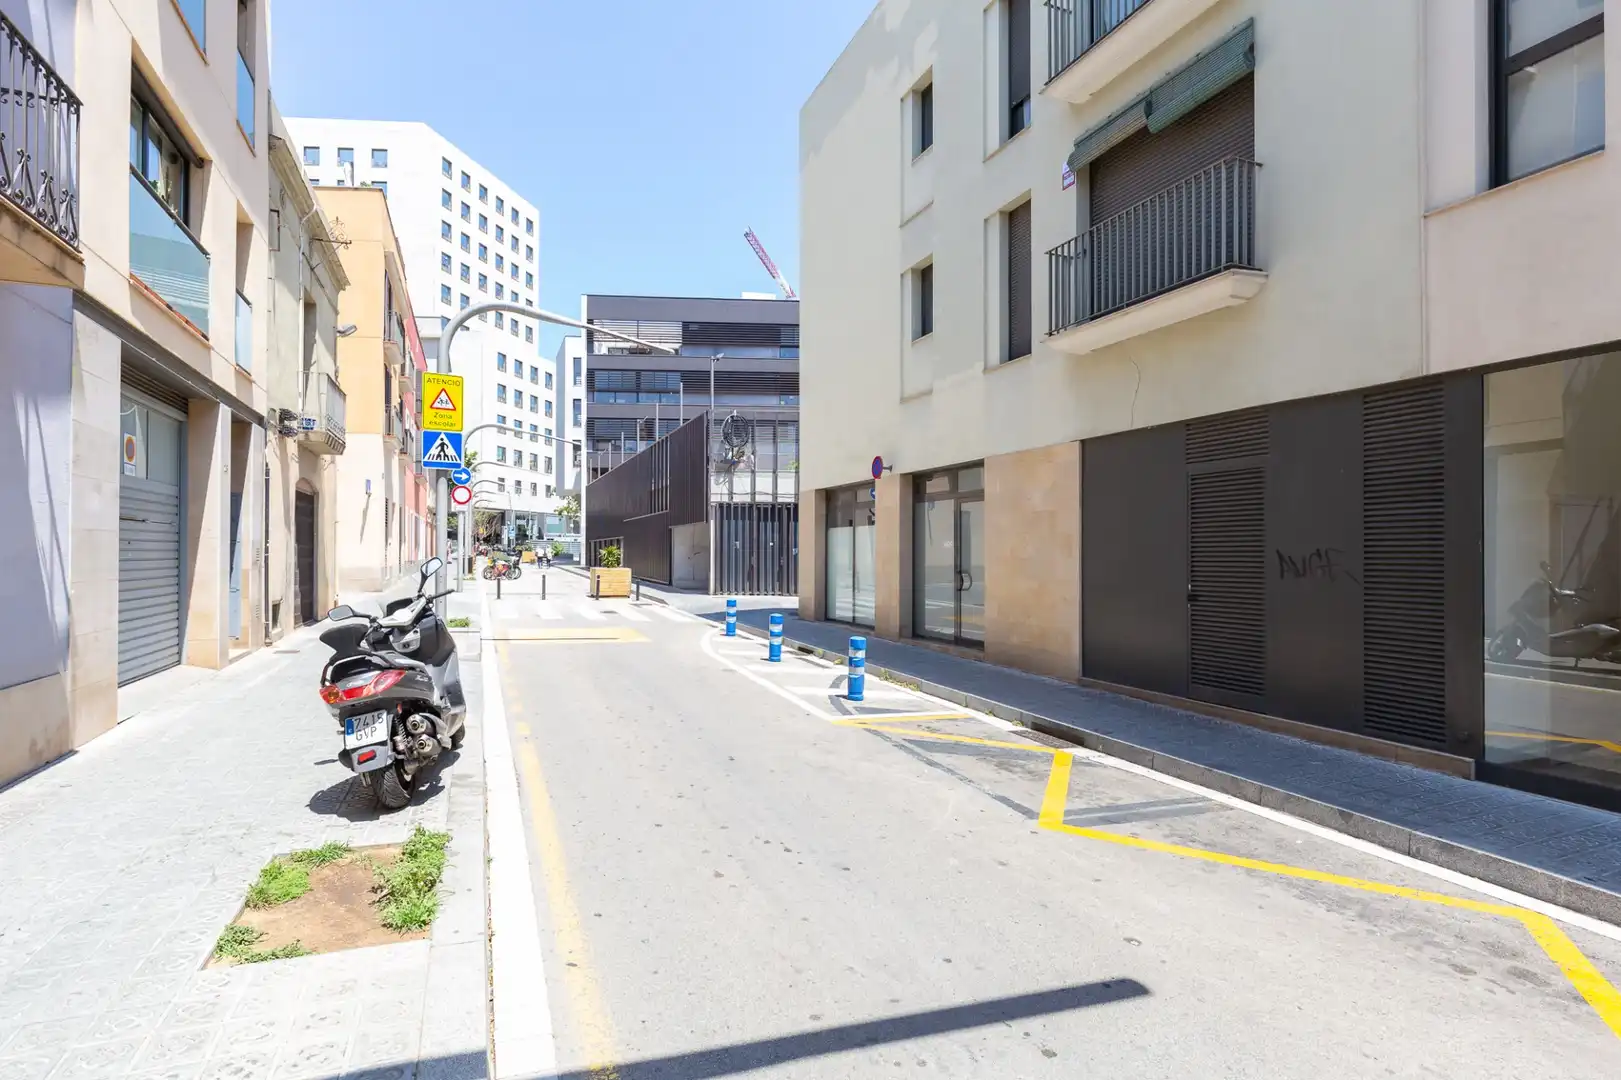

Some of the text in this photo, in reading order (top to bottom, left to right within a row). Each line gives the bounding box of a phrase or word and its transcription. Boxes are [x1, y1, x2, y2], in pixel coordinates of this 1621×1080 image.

[433, 411, 453, 419] Zona
[429, 420, 456, 428] escolar
[354, 712, 384, 730] 7415
[355, 726, 377, 741] GVP
